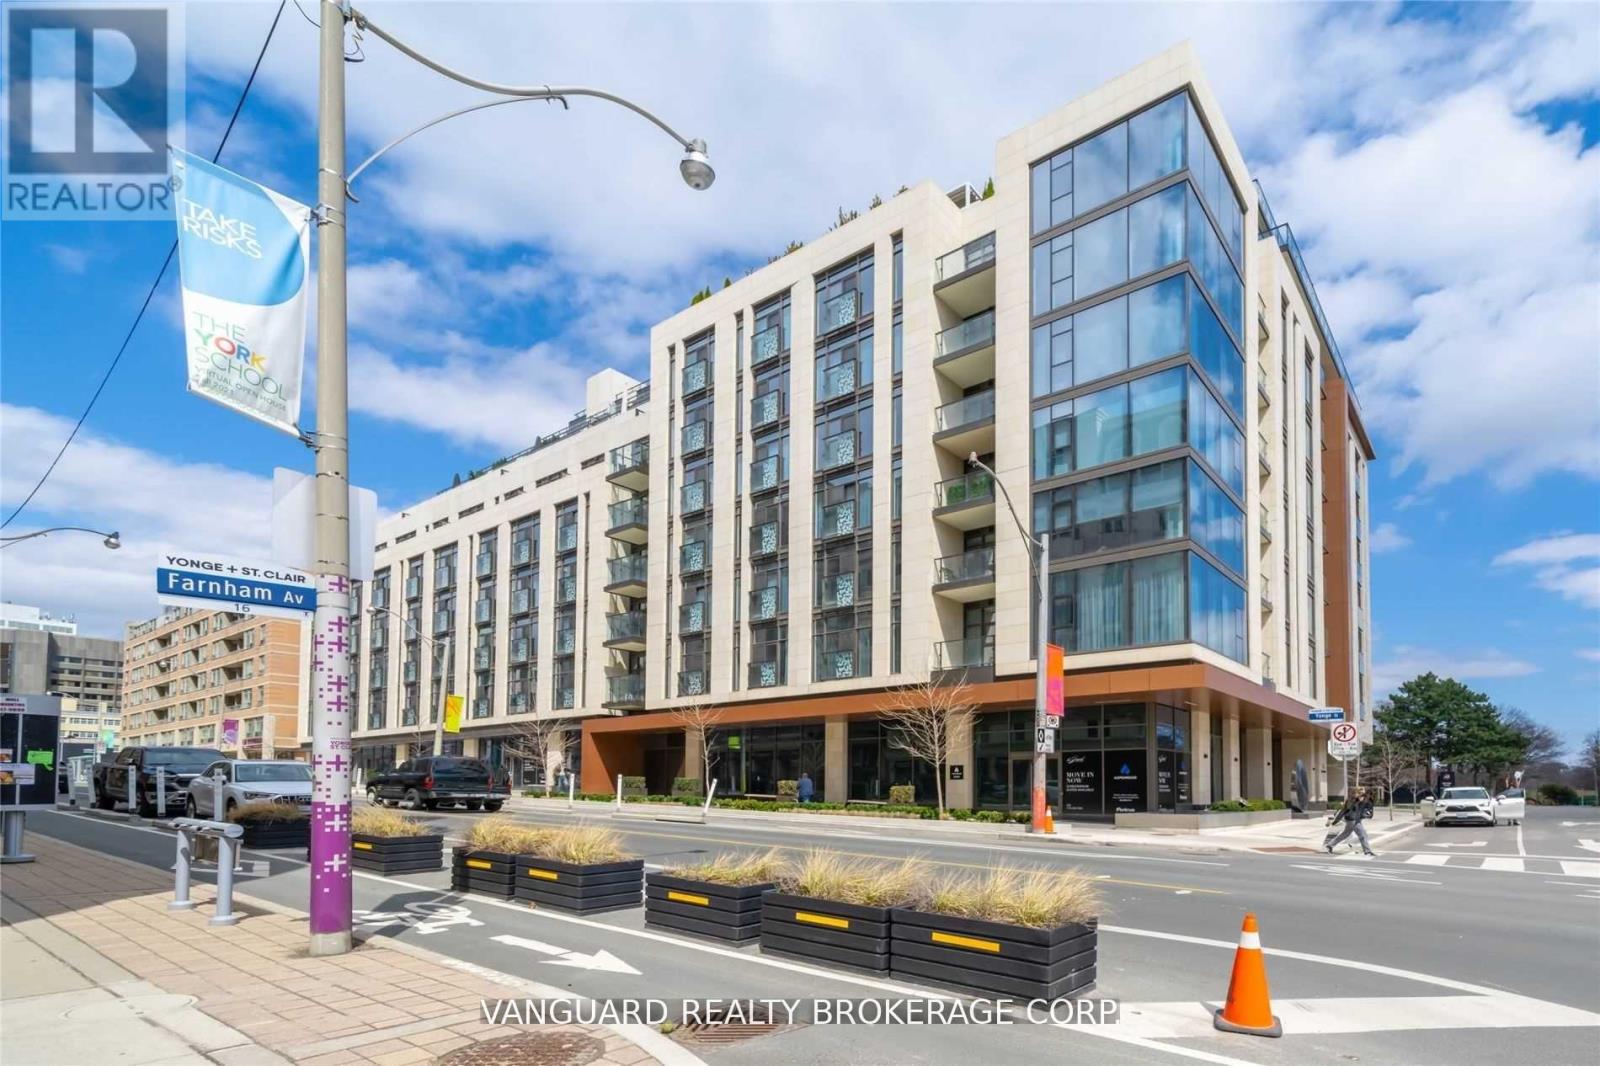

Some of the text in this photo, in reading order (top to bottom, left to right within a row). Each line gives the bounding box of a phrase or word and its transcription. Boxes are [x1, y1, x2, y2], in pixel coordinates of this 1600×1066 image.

[183, 199, 257, 237] TAKE
[183, 216, 262, 258] RISKS
[192, 311, 246, 344] THE
[194, 328, 266, 372] YORK
[195, 346, 287, 402] SCHOOL
[166, 556, 223, 572] YONGE
[263, 570, 306, 584] CLAIR
[168, 572, 304, 604] Farnham Av
[234, 603, 251, 613] 16
